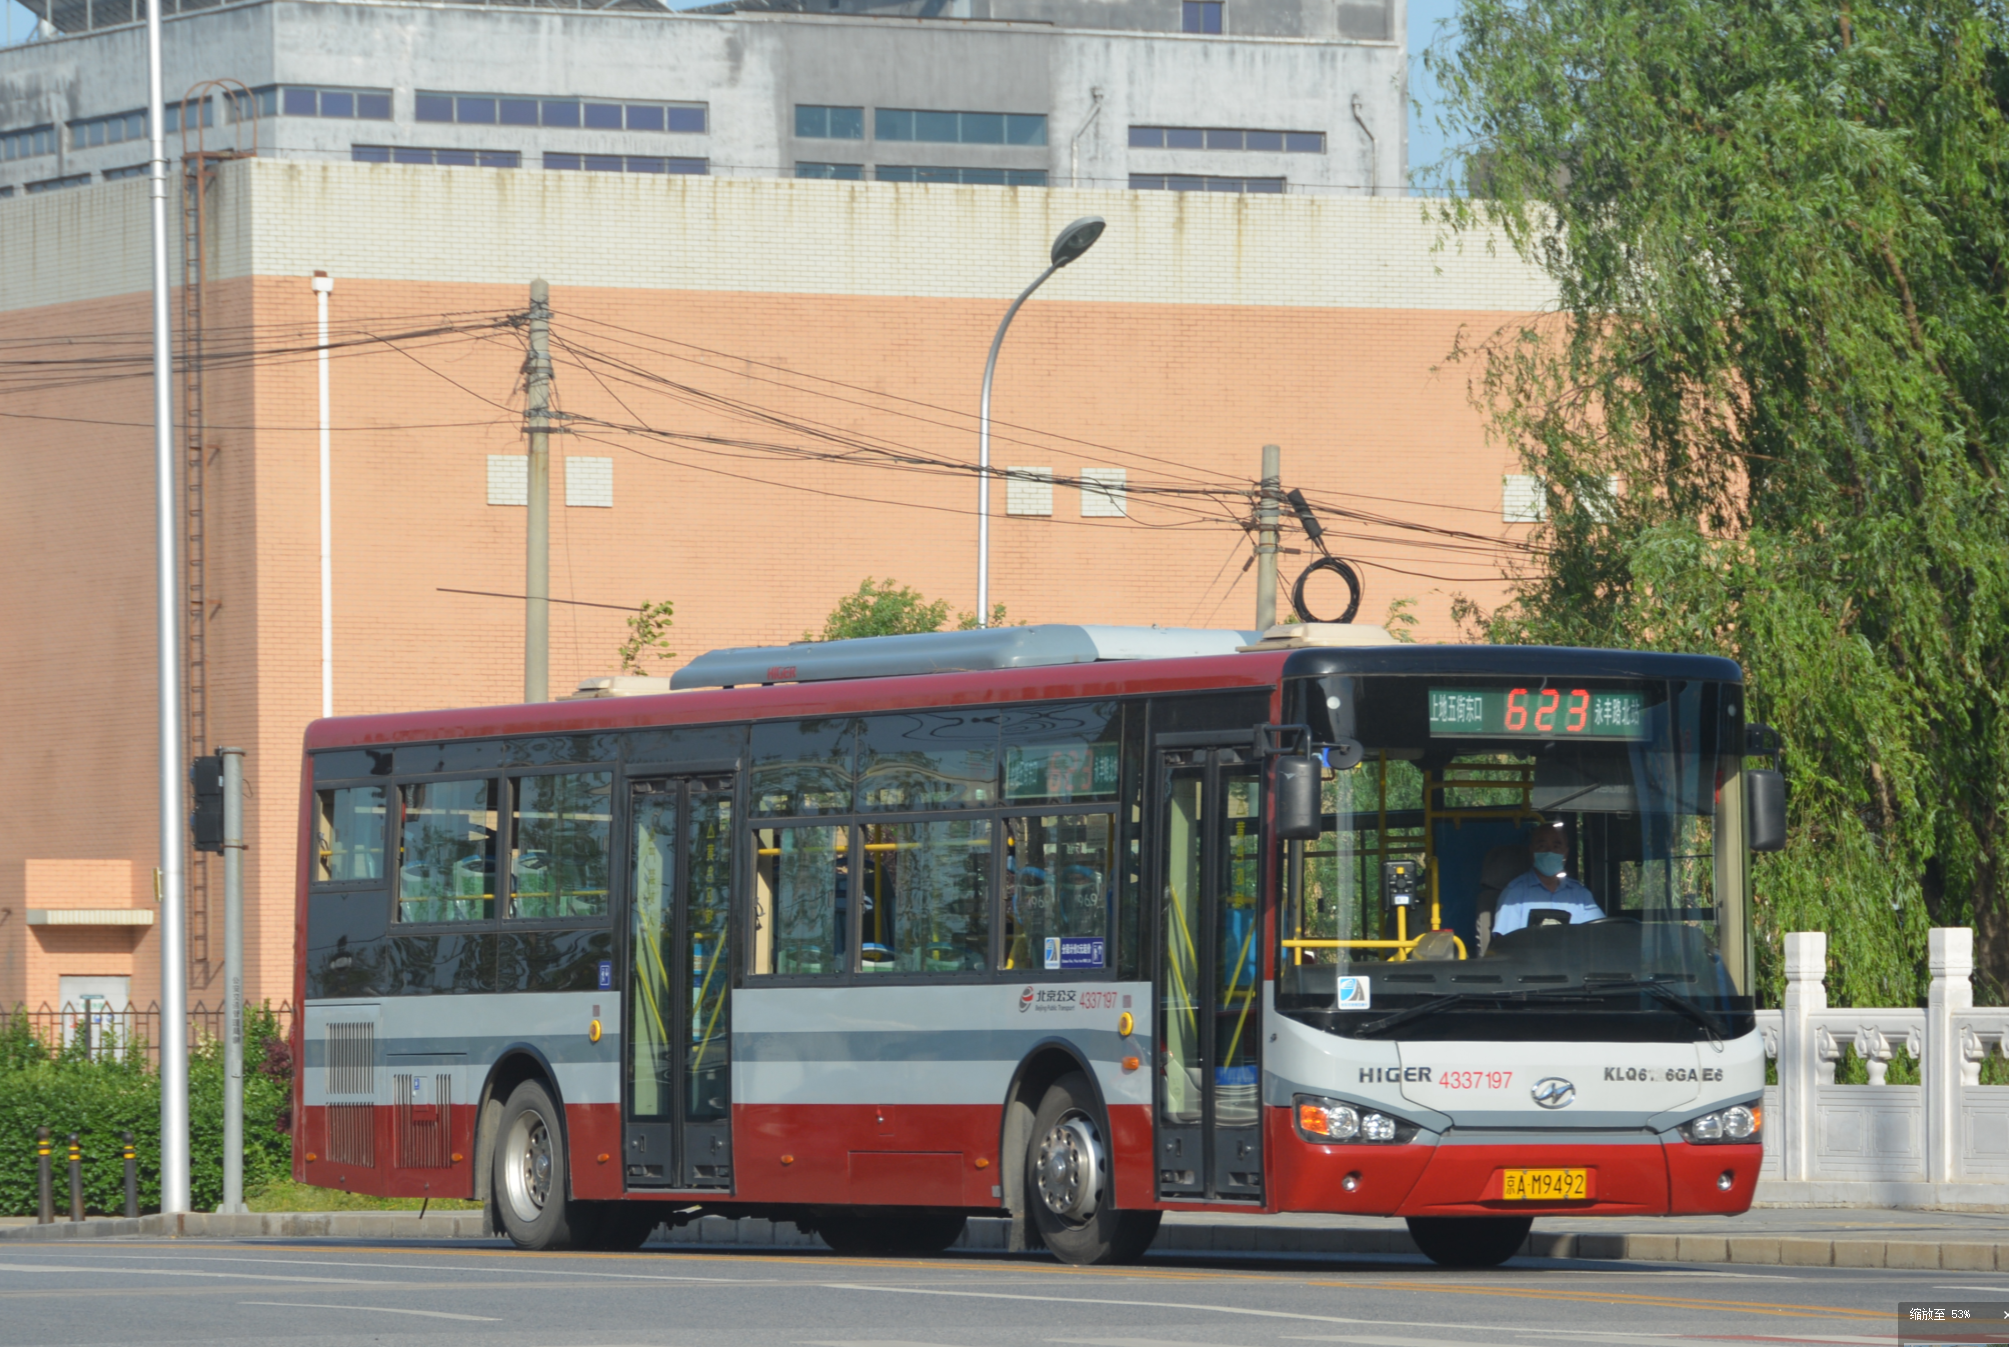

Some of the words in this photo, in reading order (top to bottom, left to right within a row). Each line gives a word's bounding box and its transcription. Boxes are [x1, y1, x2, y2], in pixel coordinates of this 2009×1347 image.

[1429, 694, 1482, 722] 上地五街东口
[1505, 688, 1590, 731] 623
[1594, 698, 1640, 725] 永丰路北站
[1036, 990, 1077, 1002] 北京公交
[1079, 991, 1118, 1009] 4337197
[1359, 1067, 1432, 1083] HIGER
[1439, 1071, 1513, 1089] 4337197
